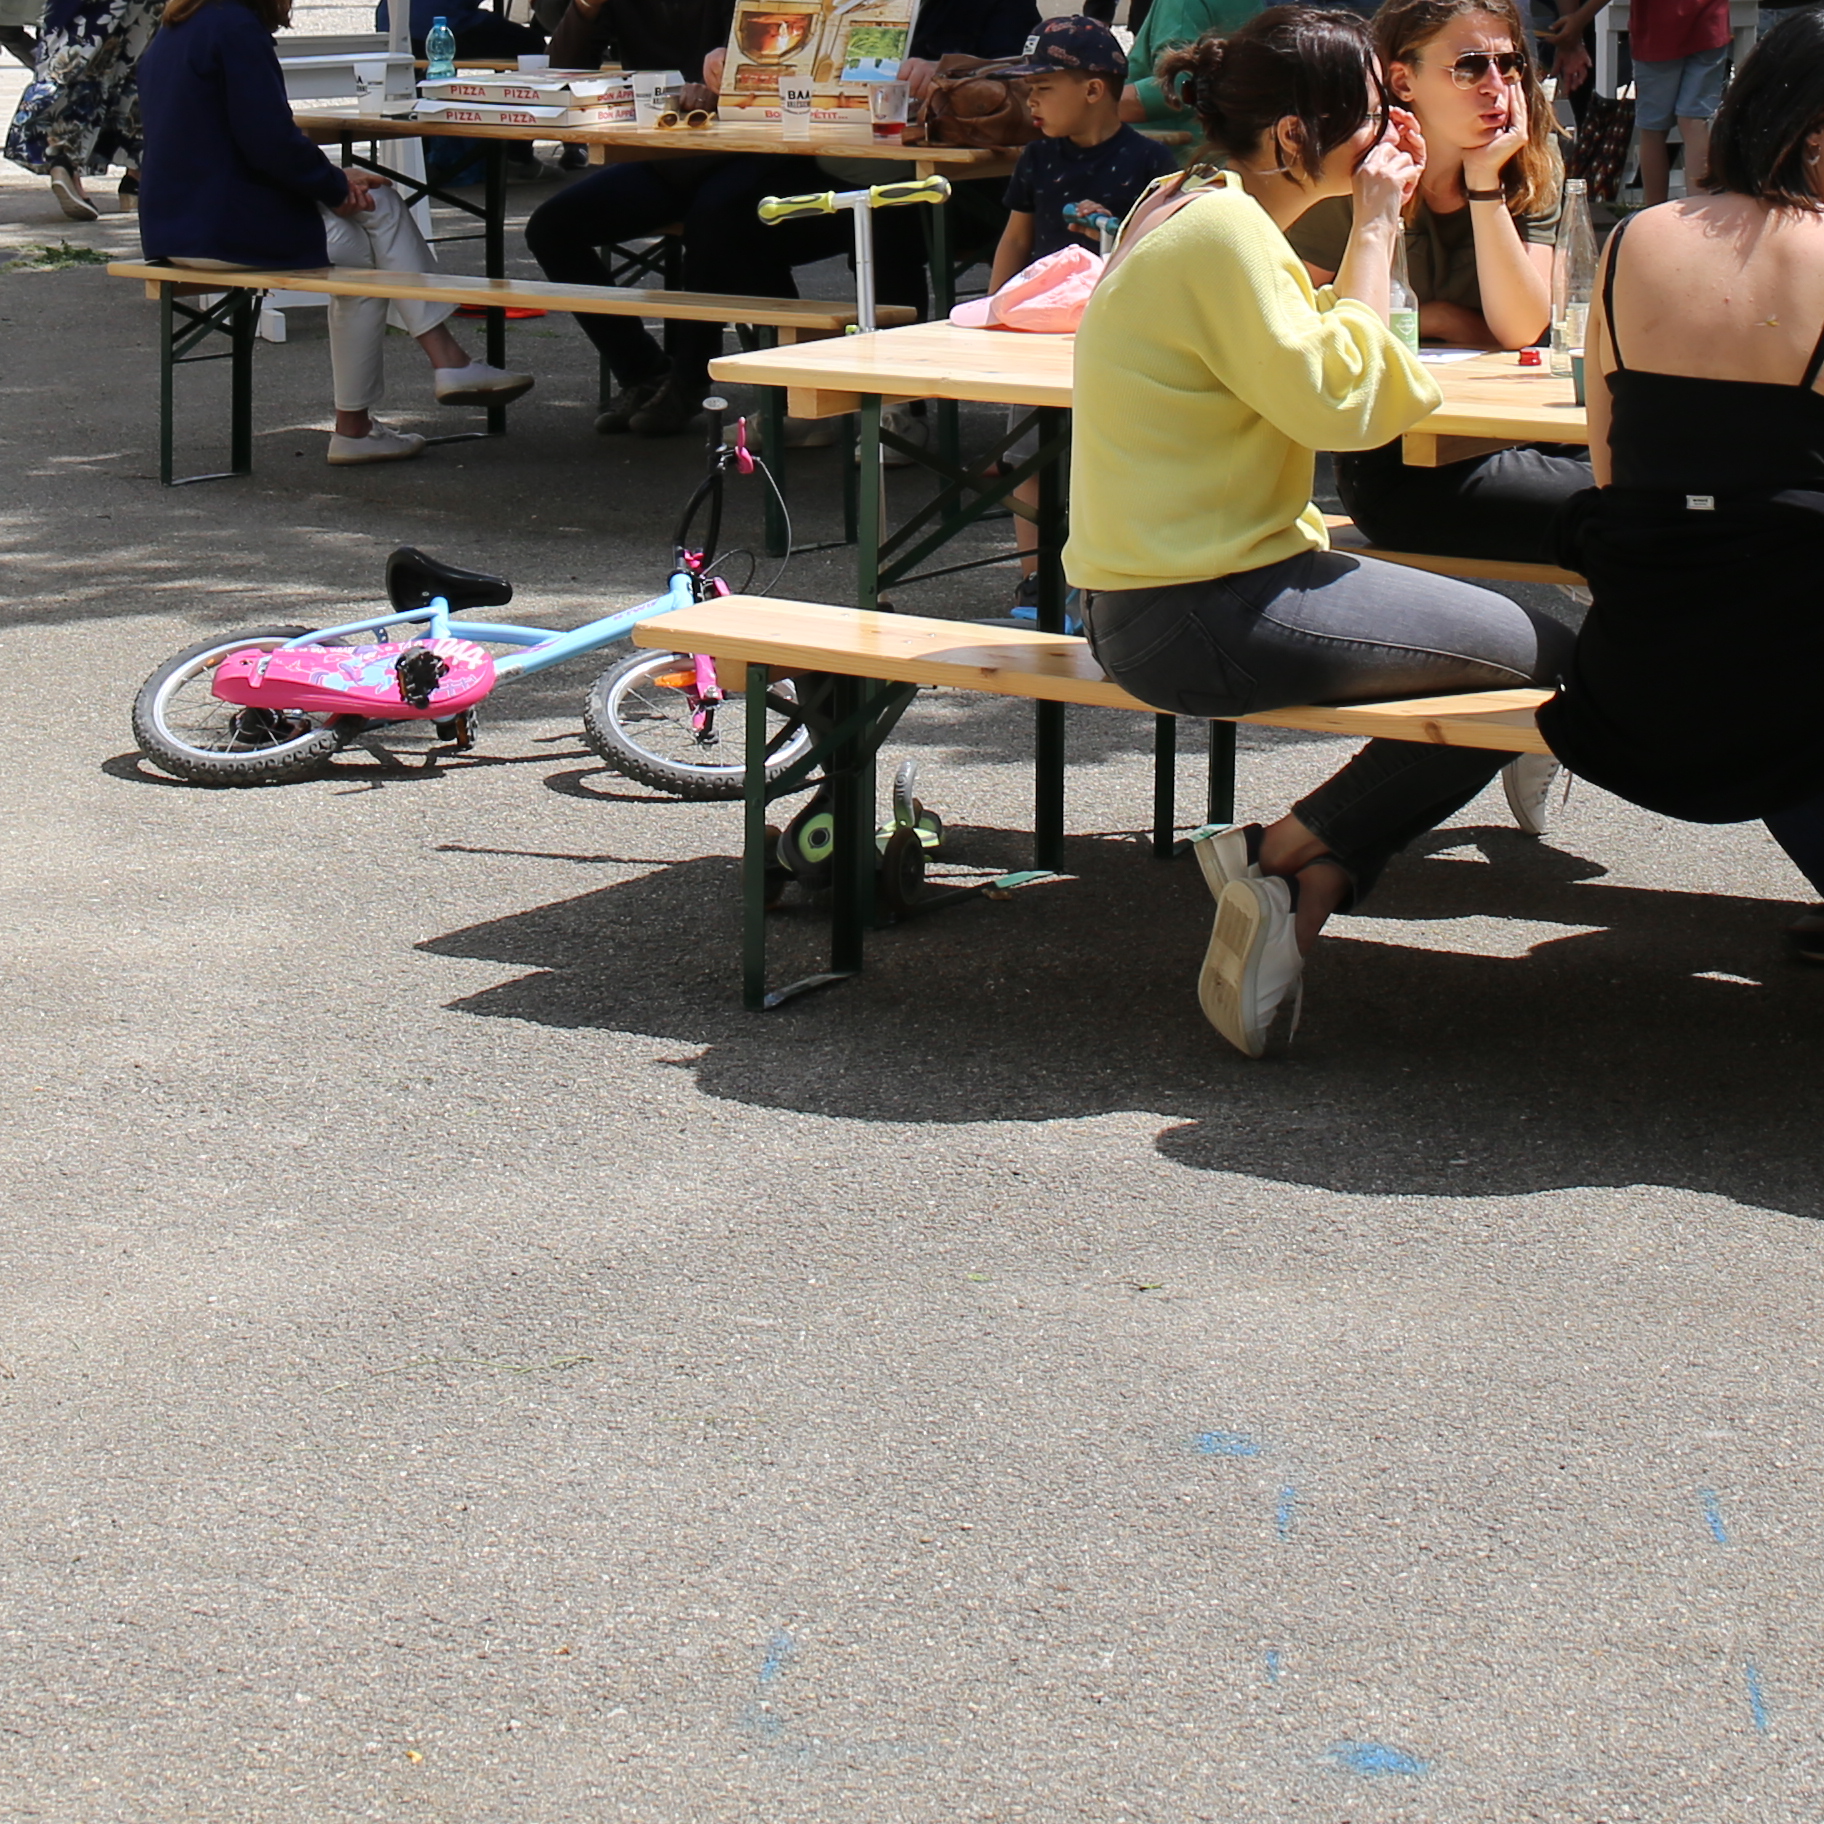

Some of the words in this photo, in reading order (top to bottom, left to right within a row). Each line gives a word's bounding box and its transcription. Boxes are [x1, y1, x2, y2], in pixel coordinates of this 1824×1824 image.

[450, 85, 486, 96] PIZZA
[504, 88, 540, 100] PIZZA
[446, 111, 482, 122] PIZZA
[500, 113, 536, 123] PIZZA
[598, 111, 613, 119] BON
